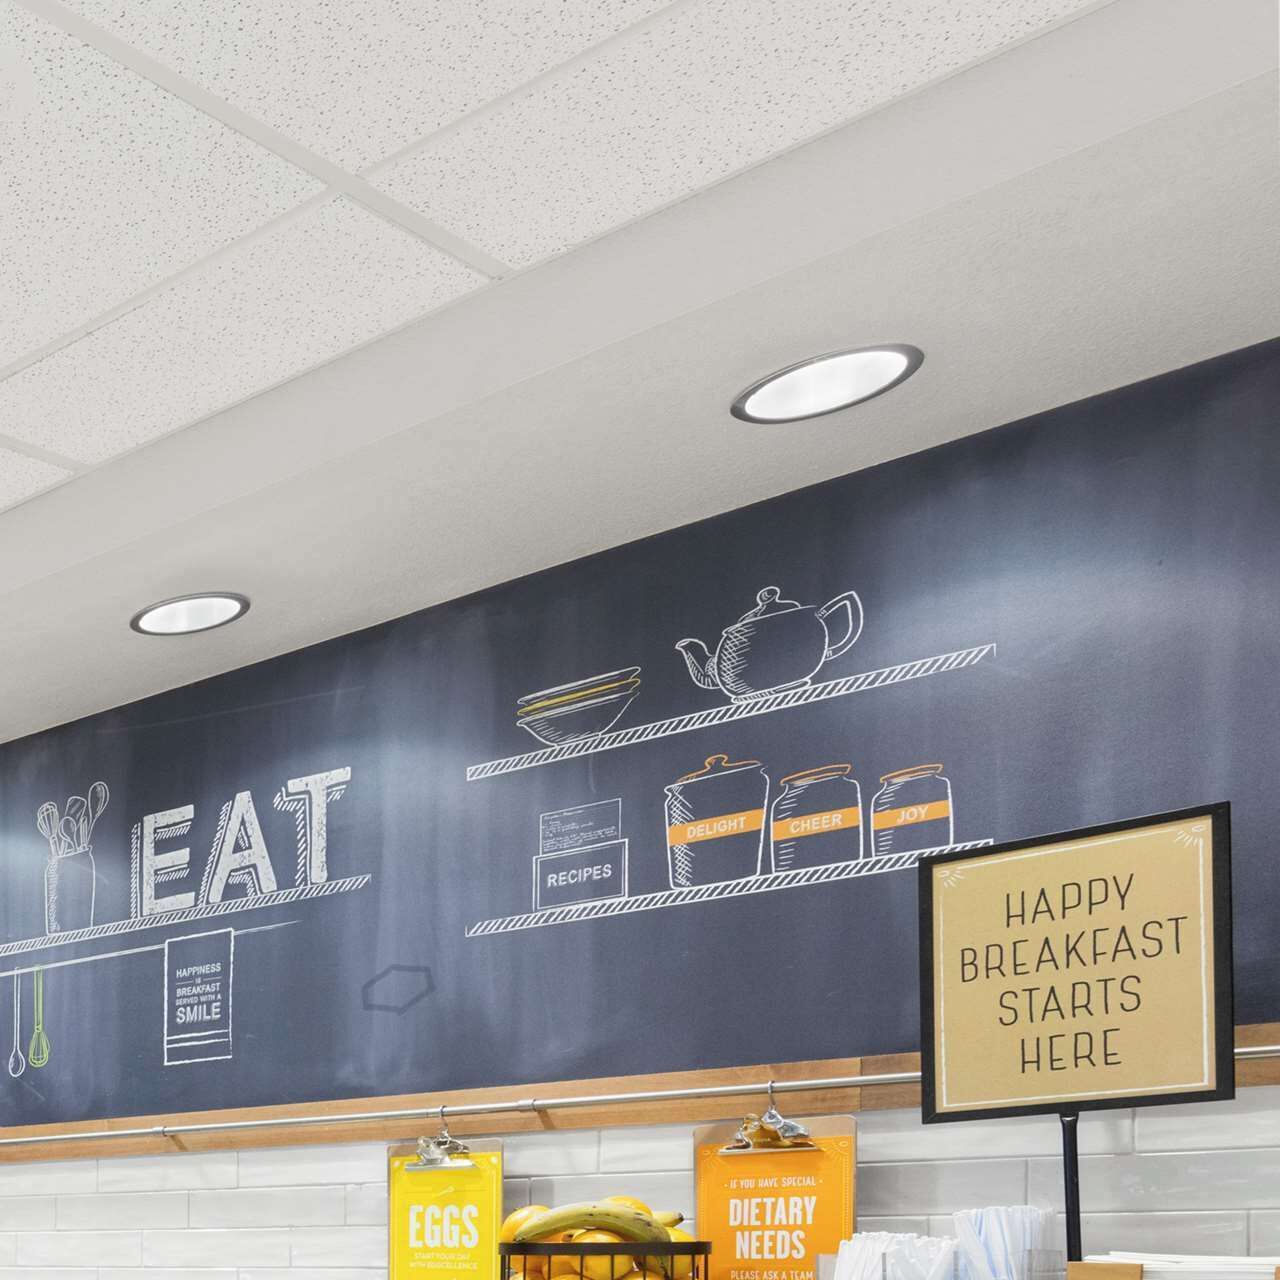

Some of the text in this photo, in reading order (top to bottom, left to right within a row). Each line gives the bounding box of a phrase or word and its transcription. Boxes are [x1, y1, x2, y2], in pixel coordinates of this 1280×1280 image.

[789, 814, 843, 834] CHEER
[896, 806, 929, 824] JOY
[687, 816, 746, 840] DELIGHT
[129, 766, 352, 920] EAT
[547, 863, 612, 888] RECIPES
[1006, 873, 1135, 928] HAPPY
[960, 916, 1188, 983] BREAKFAST
[176, 962, 221, 978] HAPPINESS
[176, 983, 221, 997] BREAKFAST
[176, 993, 222, 1006] SERVED WITH A
[998, 975, 1142, 1027] STARTS
[176, 1002, 222, 1024] SMILE
[1020, 1028, 1122, 1074] HERE
[730, 1176, 817, 1189] IF YOU HAVE SPECIAL
[729, 1196, 817, 1226] DIETARY
[408, 1204, 479, 1248] EGGS
[735, 1230, 806, 1260] NEEDS
[730, 1271, 815, 1280] PLEASE ASK A TEAM
